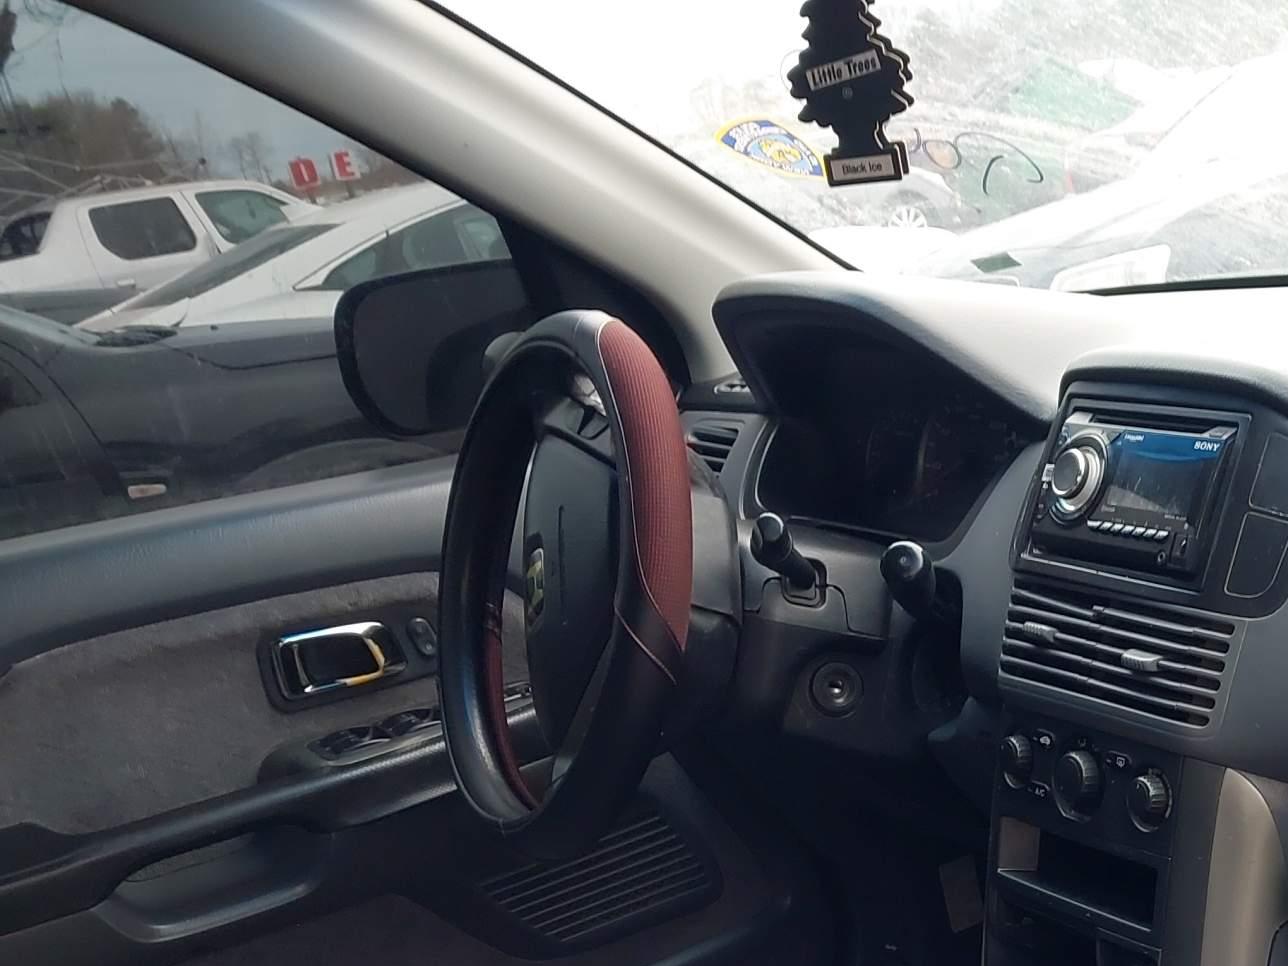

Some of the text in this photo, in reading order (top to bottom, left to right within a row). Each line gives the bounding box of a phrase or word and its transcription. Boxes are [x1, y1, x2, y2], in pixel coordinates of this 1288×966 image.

[810, 55, 877, 87] Little Trees
[841, 161, 883, 176] Black Ice
[1194, 440, 1220, 452] SONY
